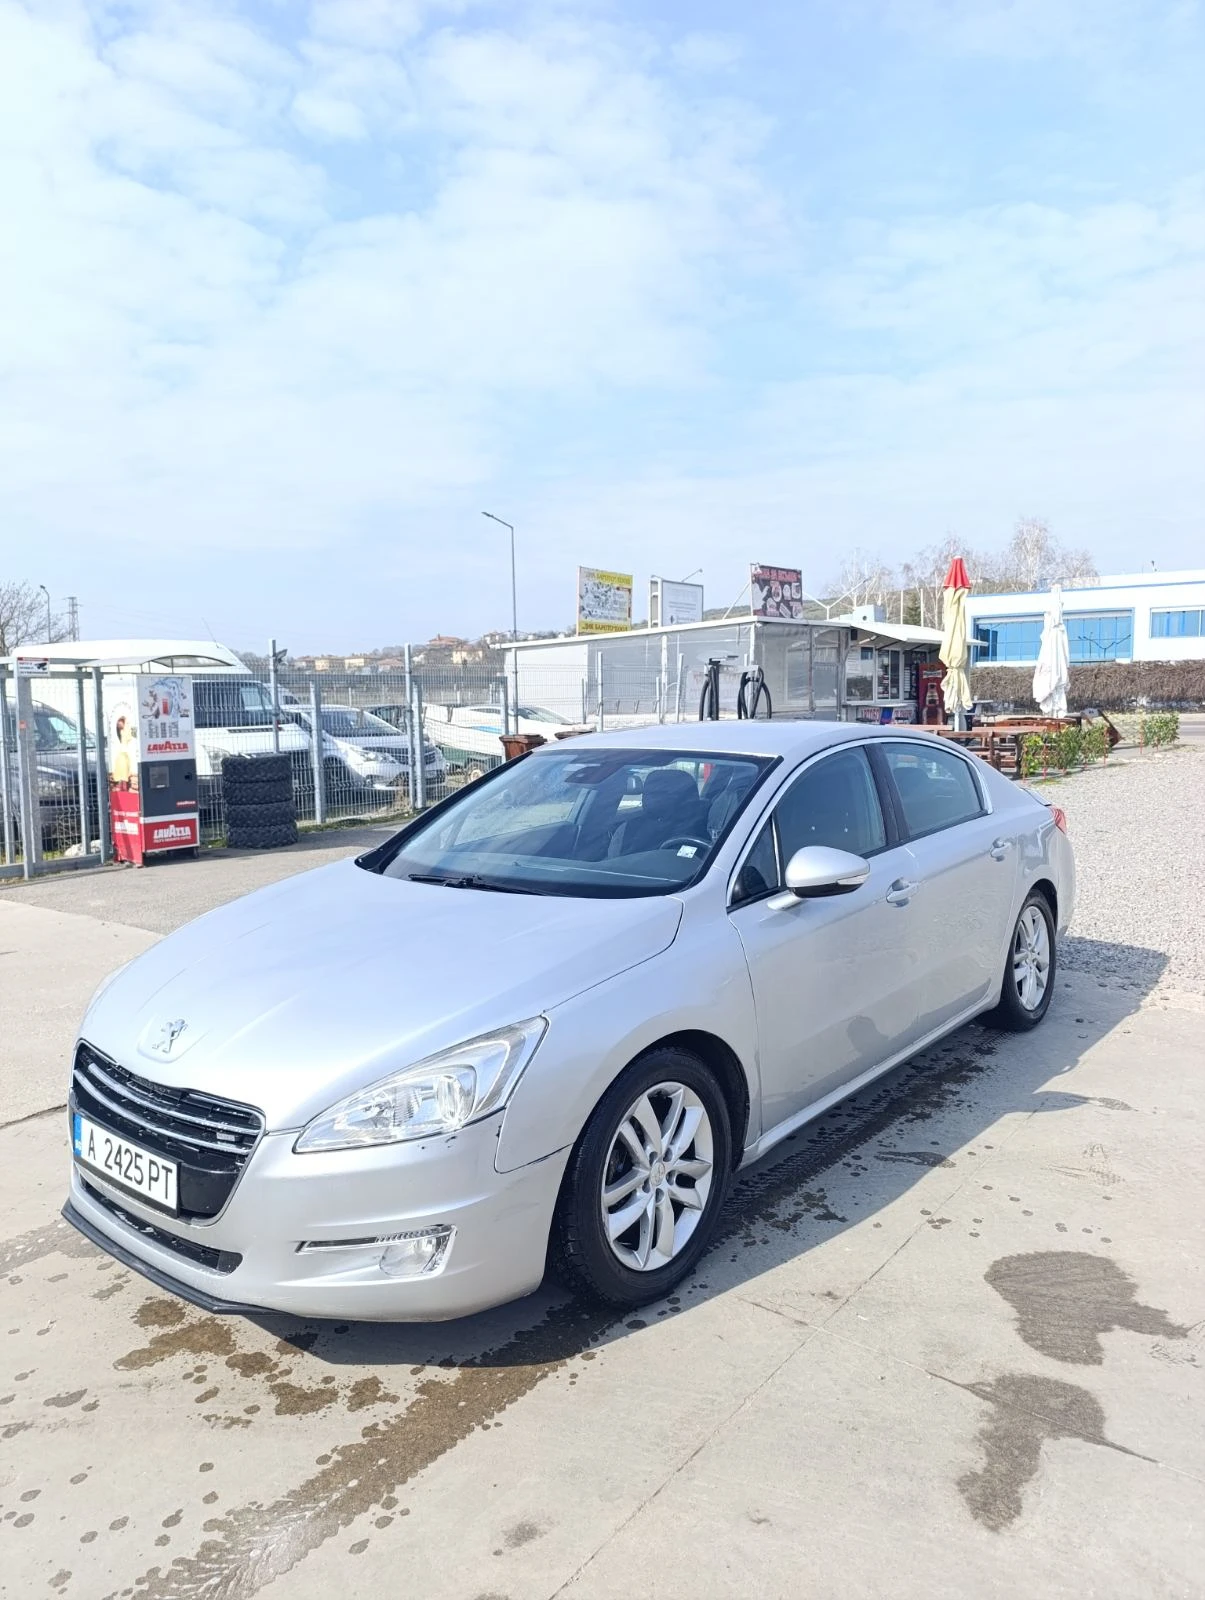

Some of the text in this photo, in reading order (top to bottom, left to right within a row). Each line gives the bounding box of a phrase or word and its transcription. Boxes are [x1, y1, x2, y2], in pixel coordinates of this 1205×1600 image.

[147, 741, 189, 752] LAVAZZA
[153, 824, 191, 839] LAVAZZA
[88, 1127, 173, 1200] A 2425 PT
